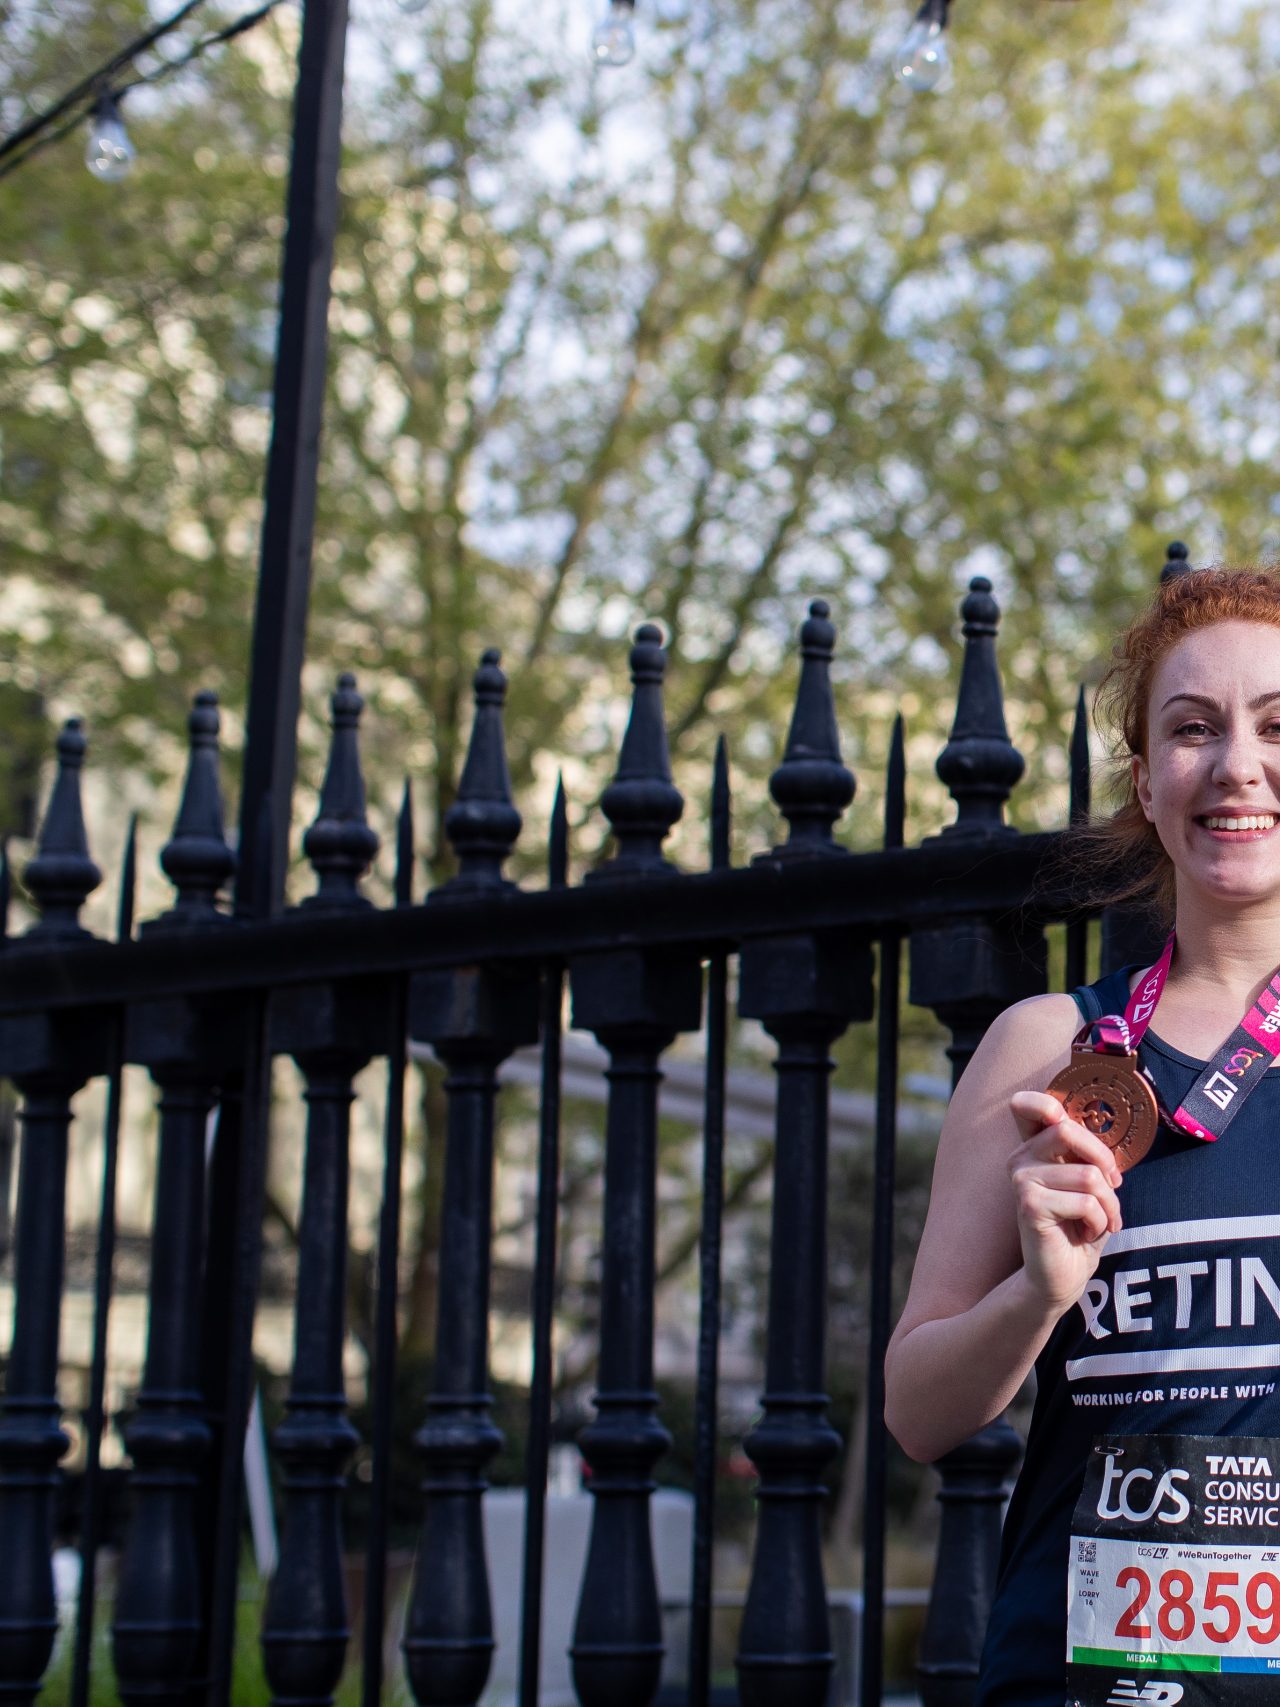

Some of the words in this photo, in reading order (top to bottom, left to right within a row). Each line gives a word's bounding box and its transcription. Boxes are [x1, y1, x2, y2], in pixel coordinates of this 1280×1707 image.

[1224, 1046, 1264, 1078] tcs
[1072, 1392, 1133, 1407] WORKING
[1134, 1389, 1165, 1403] FOR
[1169, 1385, 1230, 1401] PEOPLE
[1234, 1382, 1275, 1399] WITH
[1205, 1455, 1273, 1477] TATA
[1096, 1454, 1190, 1524] tcs
[1177, 1551, 1252, 1562] #WeRunTogether
[1080, 1569, 1100, 1577] WAVE
[1078, 1590, 1100, 1598] LORRY
[1126, 1652, 1158, 1664] MEDAL
